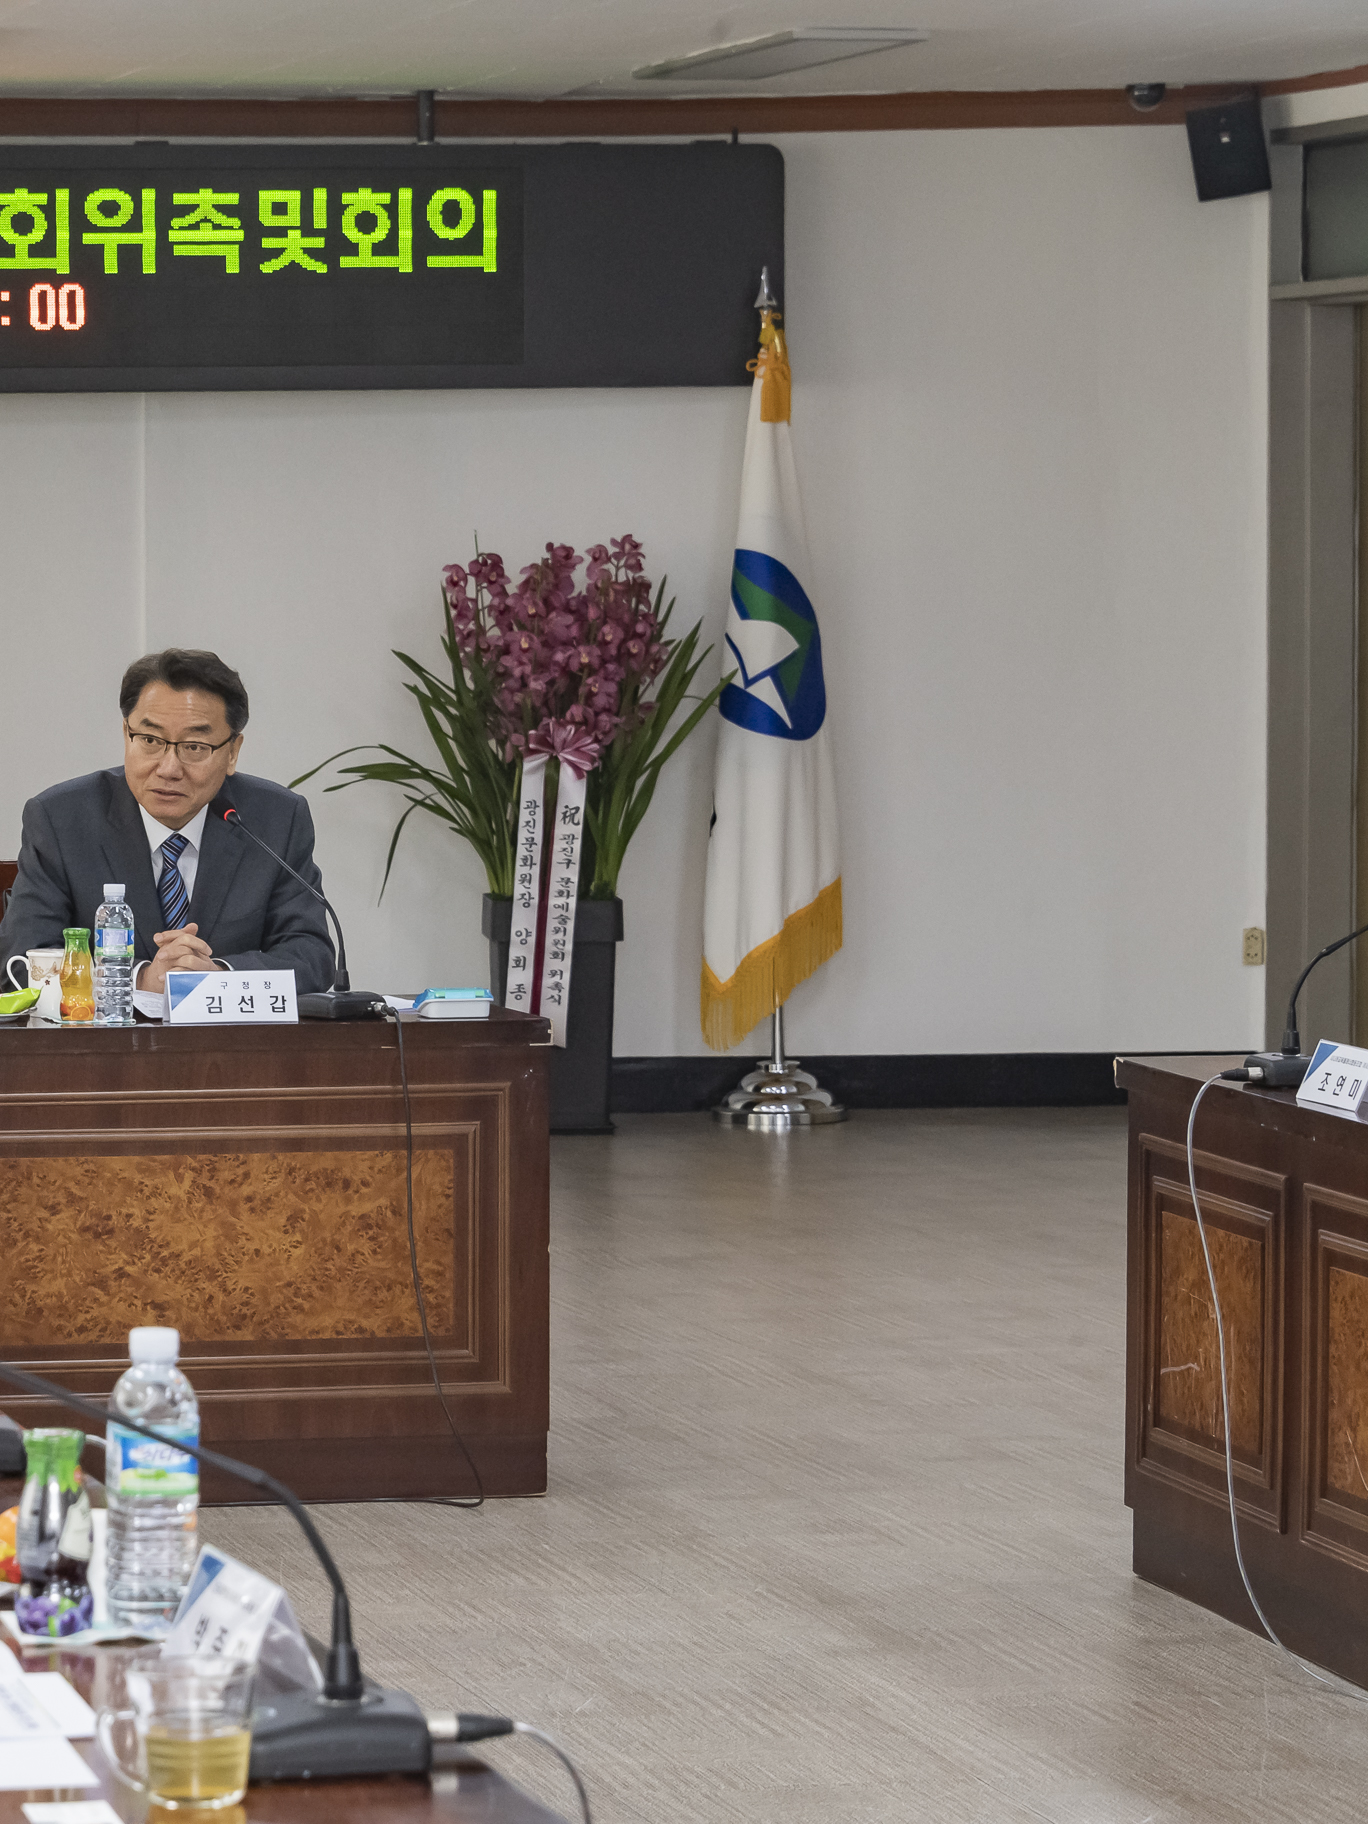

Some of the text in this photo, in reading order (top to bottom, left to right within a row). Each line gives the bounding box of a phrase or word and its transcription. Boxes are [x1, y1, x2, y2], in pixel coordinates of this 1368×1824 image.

[518, 799, 541, 909] 광진문화원장
[545, 804, 581, 1006] 祝 광진구 문화예술위원회 위촉식
